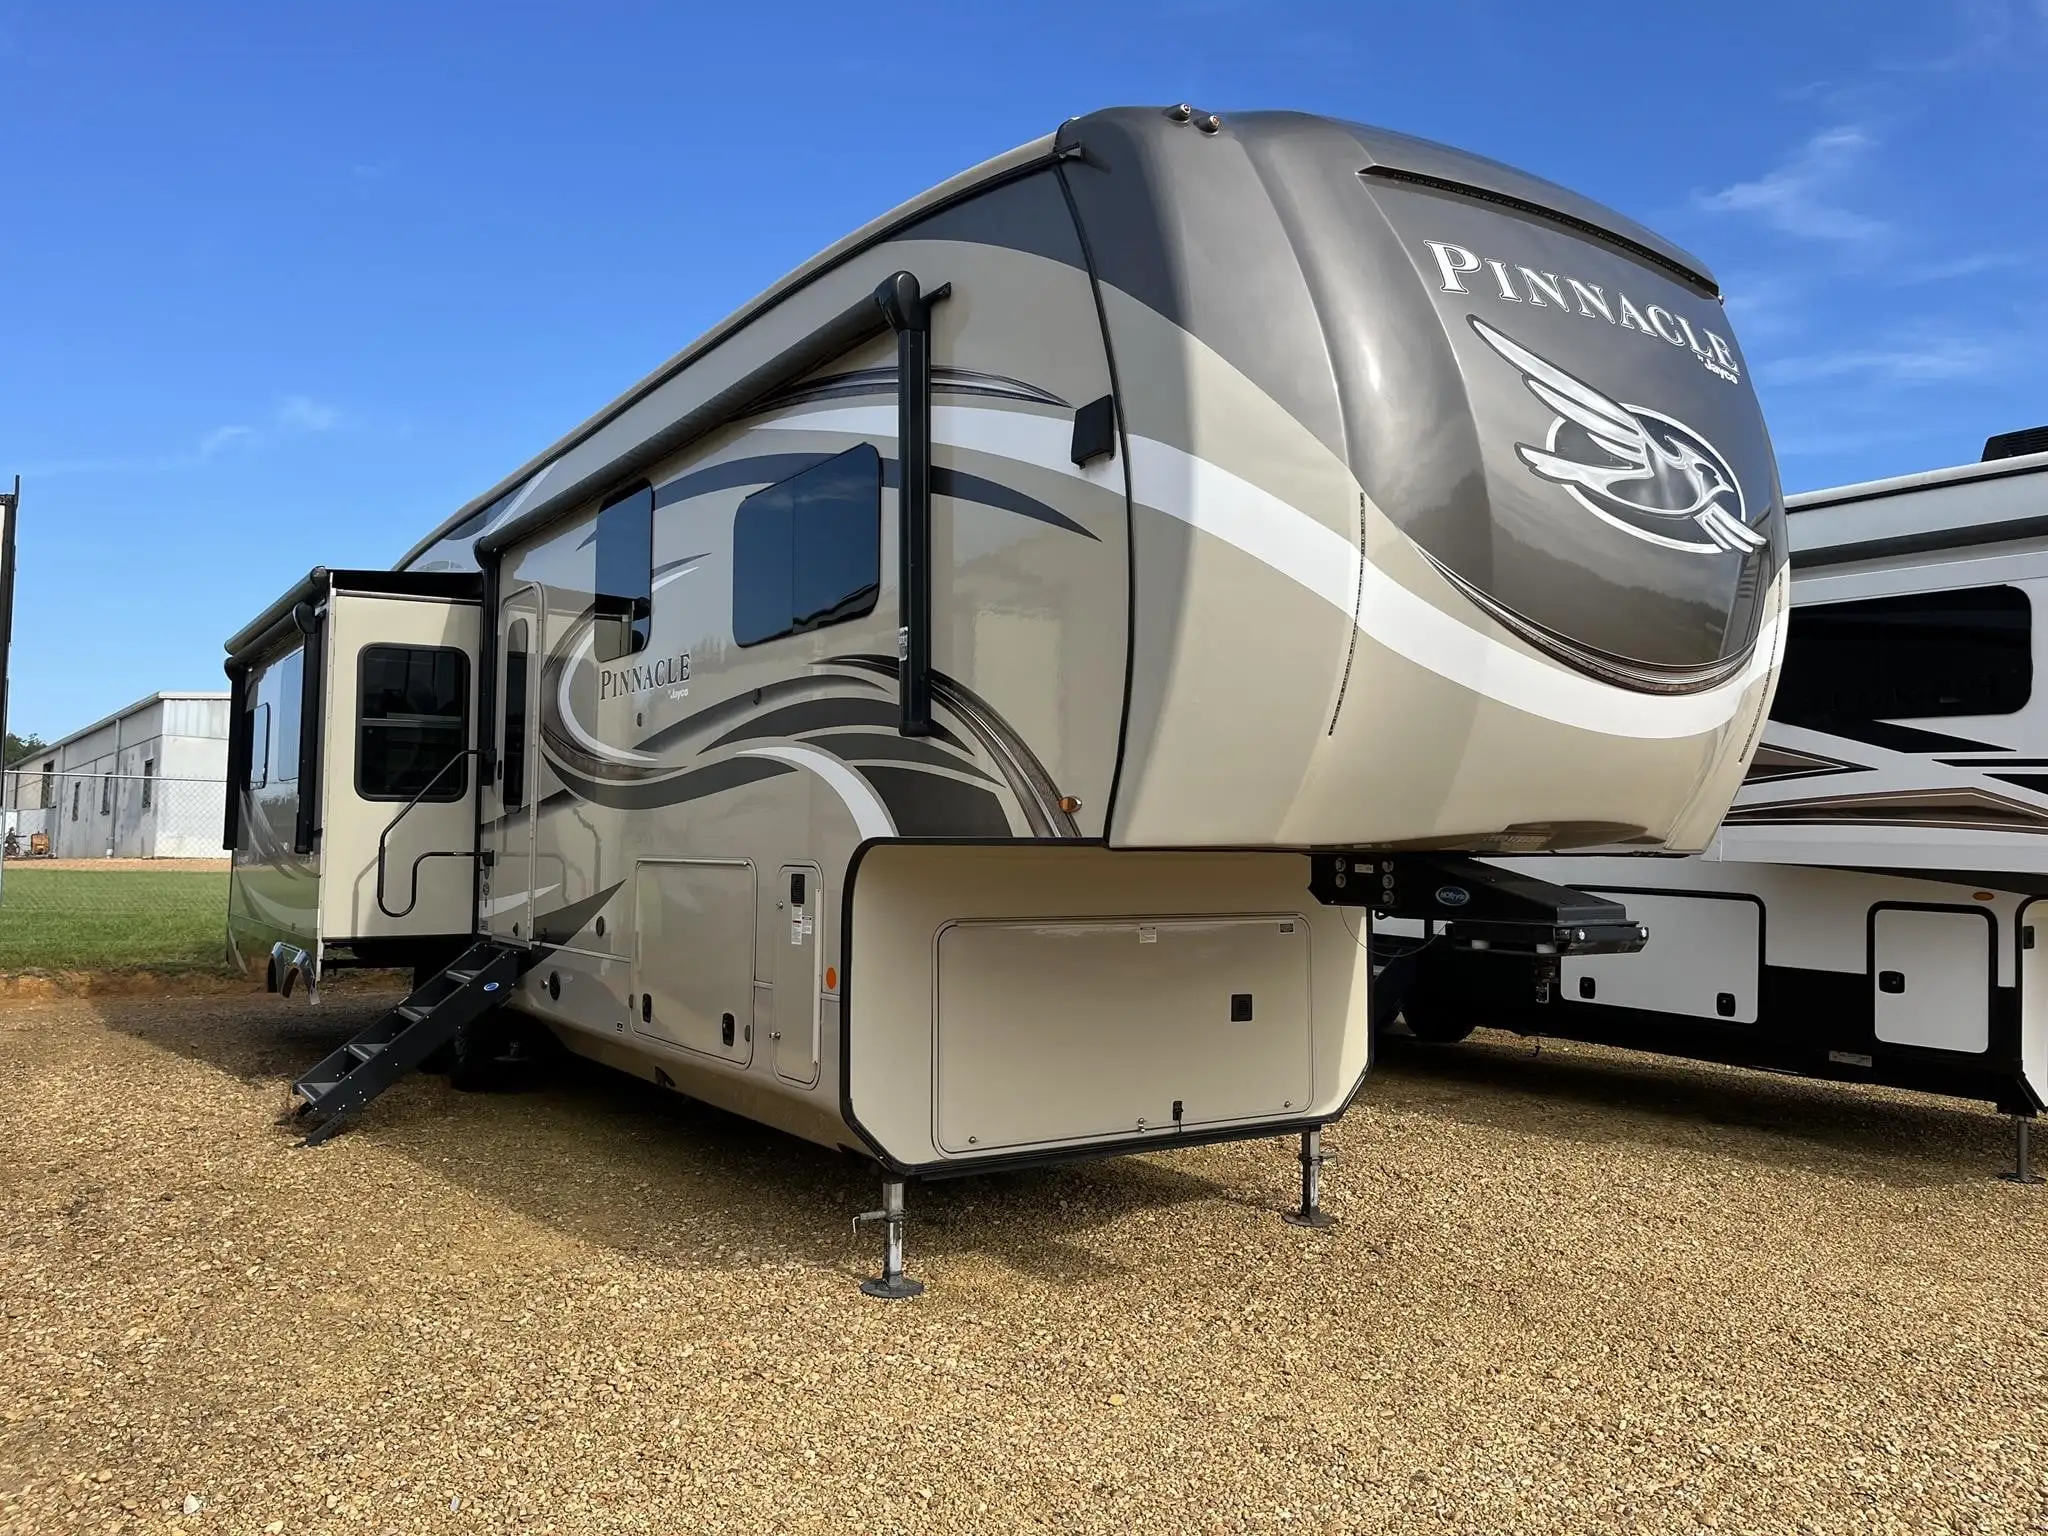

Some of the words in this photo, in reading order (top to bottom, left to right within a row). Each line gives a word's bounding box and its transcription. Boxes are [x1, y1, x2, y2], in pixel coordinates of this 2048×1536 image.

[1424, 240, 1740, 376] PINNACLE
[1704, 358, 1738, 384] Jayco
[600, 653, 690, 701] PINNACLE
